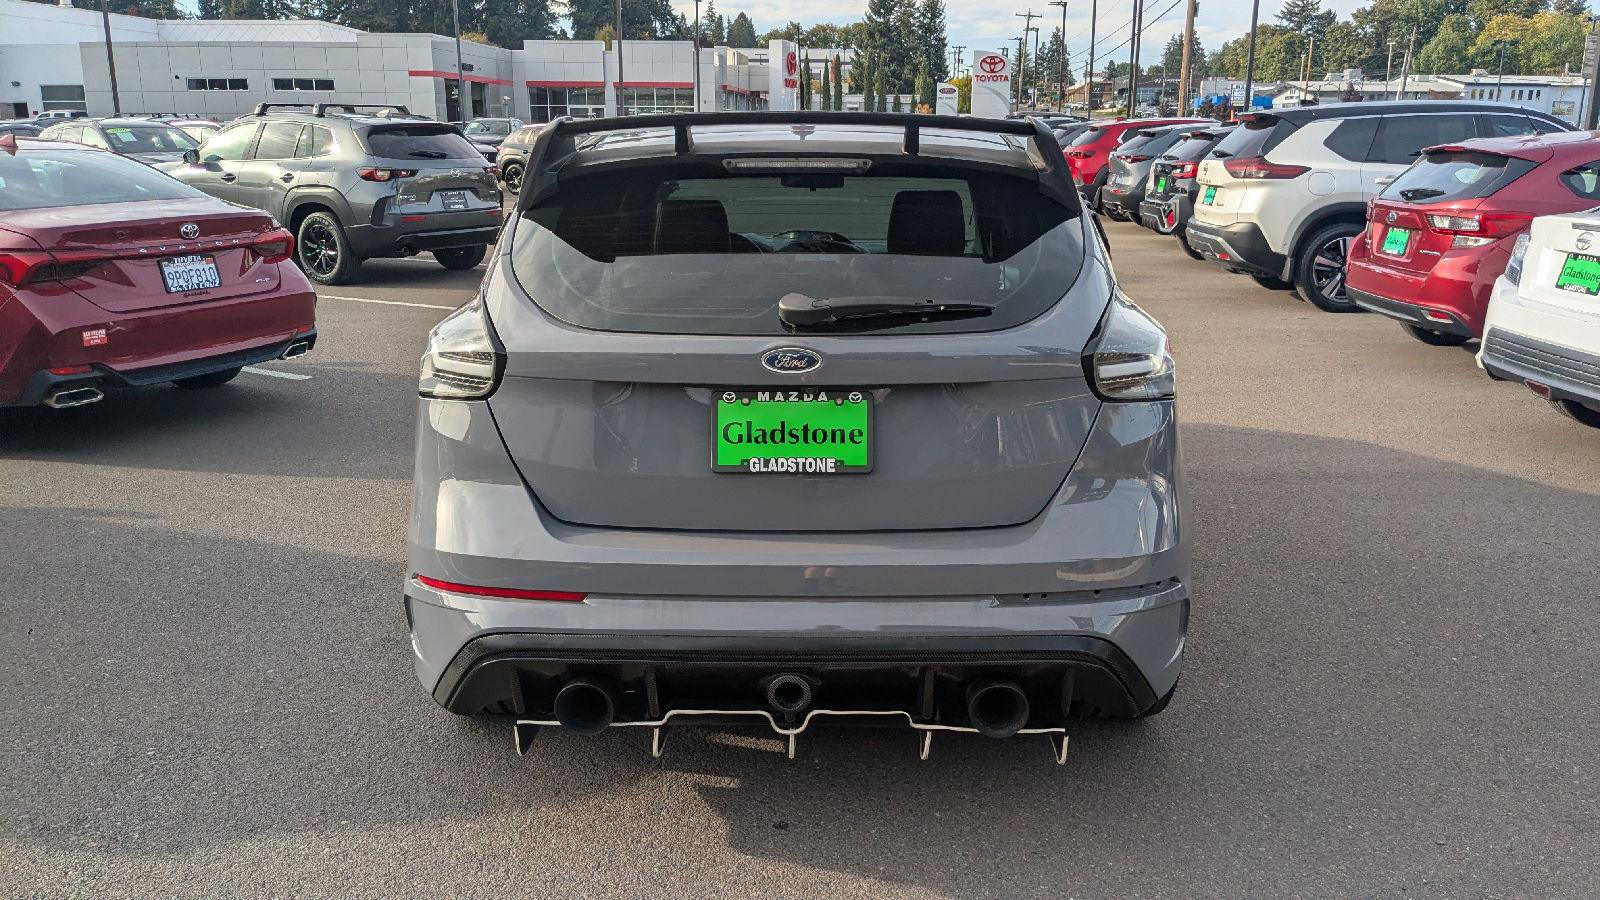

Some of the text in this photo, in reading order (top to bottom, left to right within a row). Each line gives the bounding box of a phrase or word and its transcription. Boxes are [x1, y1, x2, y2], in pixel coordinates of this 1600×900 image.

[974, 74, 1009, 82] TOYOTA
[173, 255, 202, 264] TOYOTA
[1563, 266, 1600, 283] Gladstone
[774, 353, 809, 369] Ford
[757, 391, 829, 403] MAZDA
[722, 420, 864, 445] Gladstone
[749, 457, 836, 474] GLADSTONE
